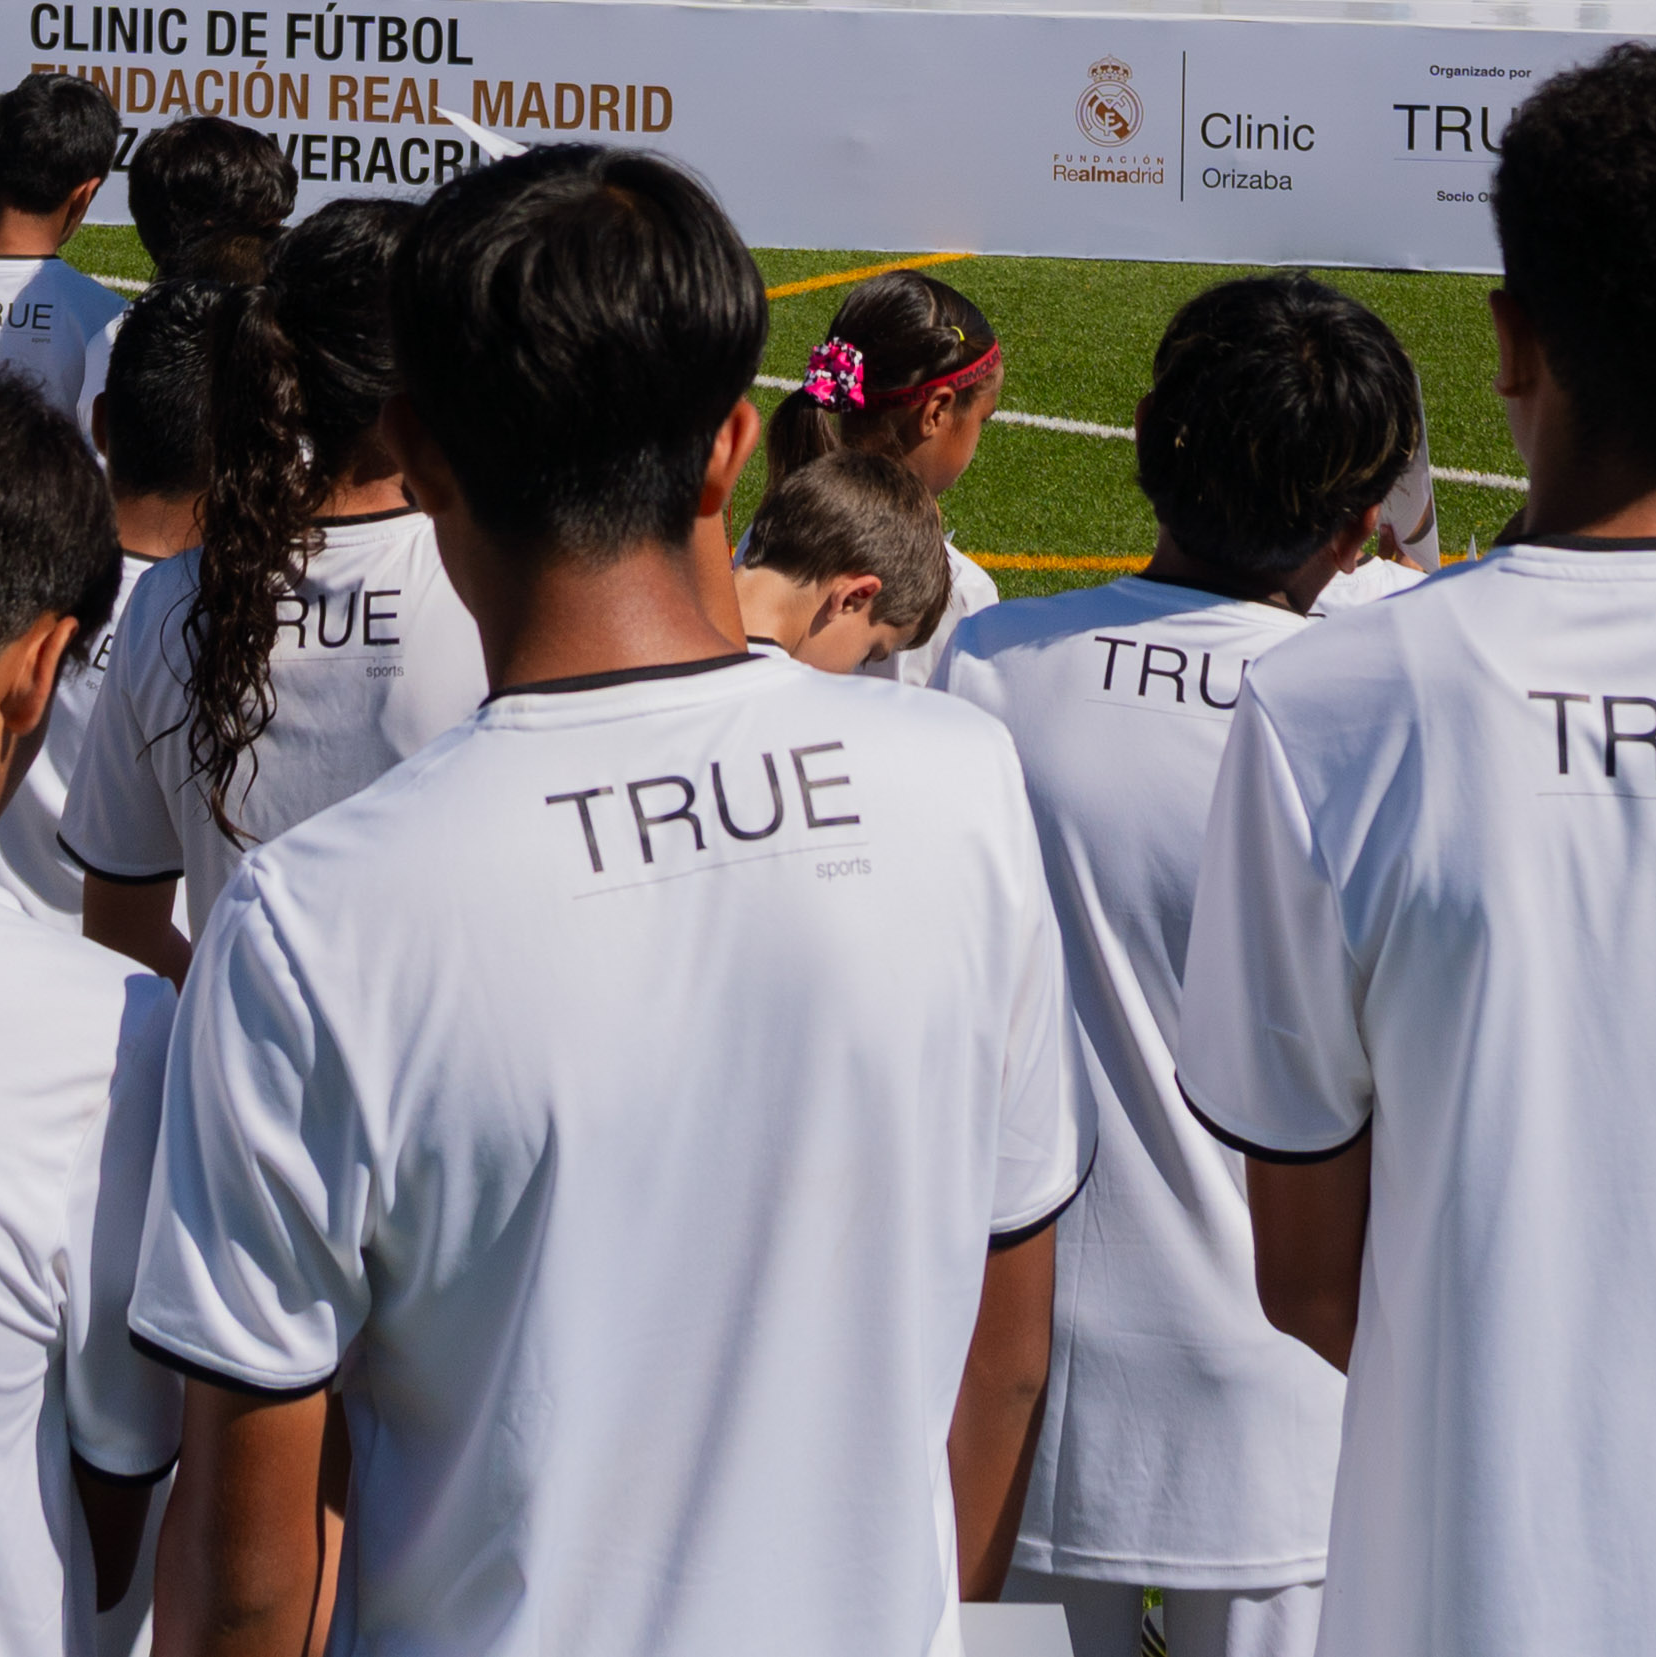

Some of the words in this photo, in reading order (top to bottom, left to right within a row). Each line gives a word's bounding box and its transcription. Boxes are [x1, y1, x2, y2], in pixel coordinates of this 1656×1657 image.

[30, 3, 188, 55] CLINIC
[206, 11, 268, 58] DE
[286, 3, 473, 66] FÚTBOL
[1430, 65, 1505, 78] Organizado
[1509, 70, 1532, 80] por
[329, 75, 452, 128] REAL
[472, 80, 674, 133] MADRID
[1201, 113, 1314, 151] Clinic
[1393, 104, 1518, 153] TRU
[1054, 154, 1164, 168] FUNDACIÓN
[1054, 165, 1163, 184] Realmadrid
[1202, 168, 1292, 190] Orizaba
[1437, 191, 1474, 202] Socio
[275, 590, 401, 648] RUE
[366, 665, 404, 679] sports
[1095, 636, 1250, 710] TRU
[545, 742, 862, 874] TRUE
[816, 853, 872, 880] sports
